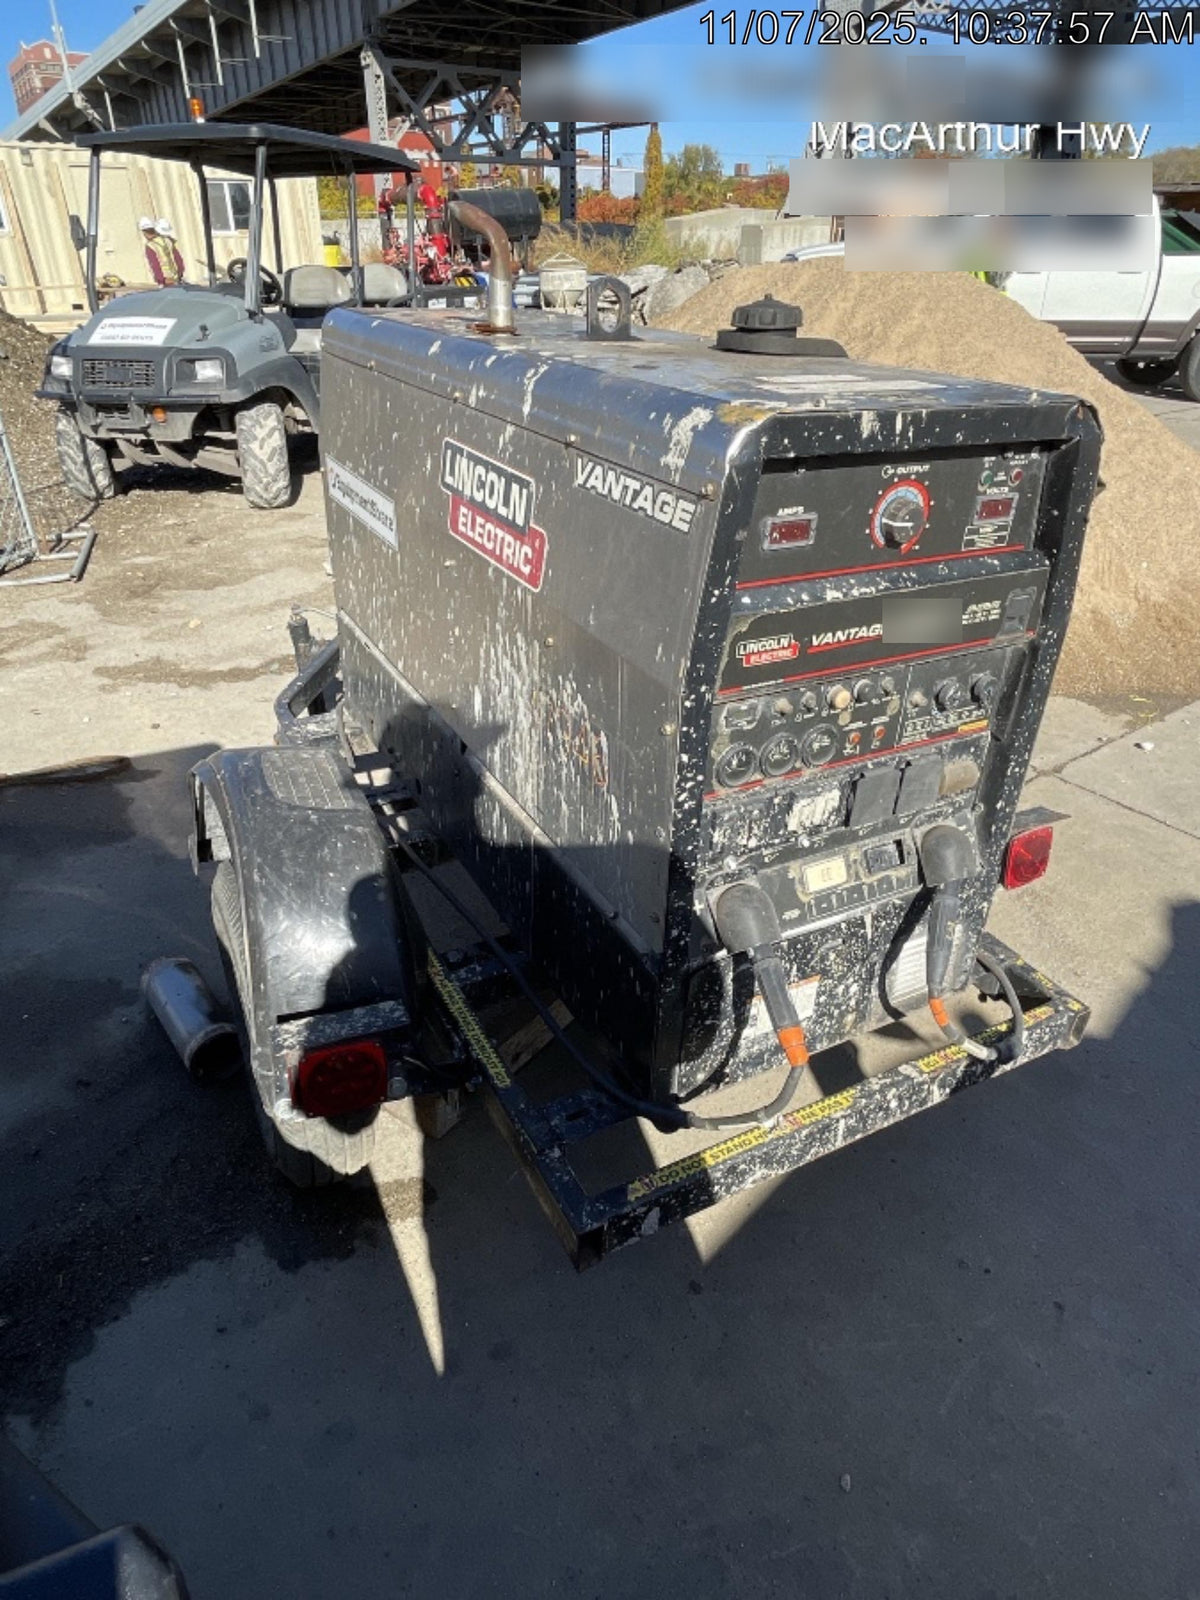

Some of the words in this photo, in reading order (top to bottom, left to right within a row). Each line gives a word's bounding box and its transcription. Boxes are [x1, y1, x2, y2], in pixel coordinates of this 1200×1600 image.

[444, 449, 528, 527] LINCOLN
[573, 457, 697, 533] VANTAGE
[458, 505, 533, 576] ELECTRIC
[739, 636, 790, 655] LINCOLN
[750, 648, 794, 664] ELECTRIC
[812, 623, 883, 646] VANTAG
[659, 1168, 680, 1183] DO
[682, 1157, 709, 1174] NOT
[709, 1138, 753, 1160] STAND
